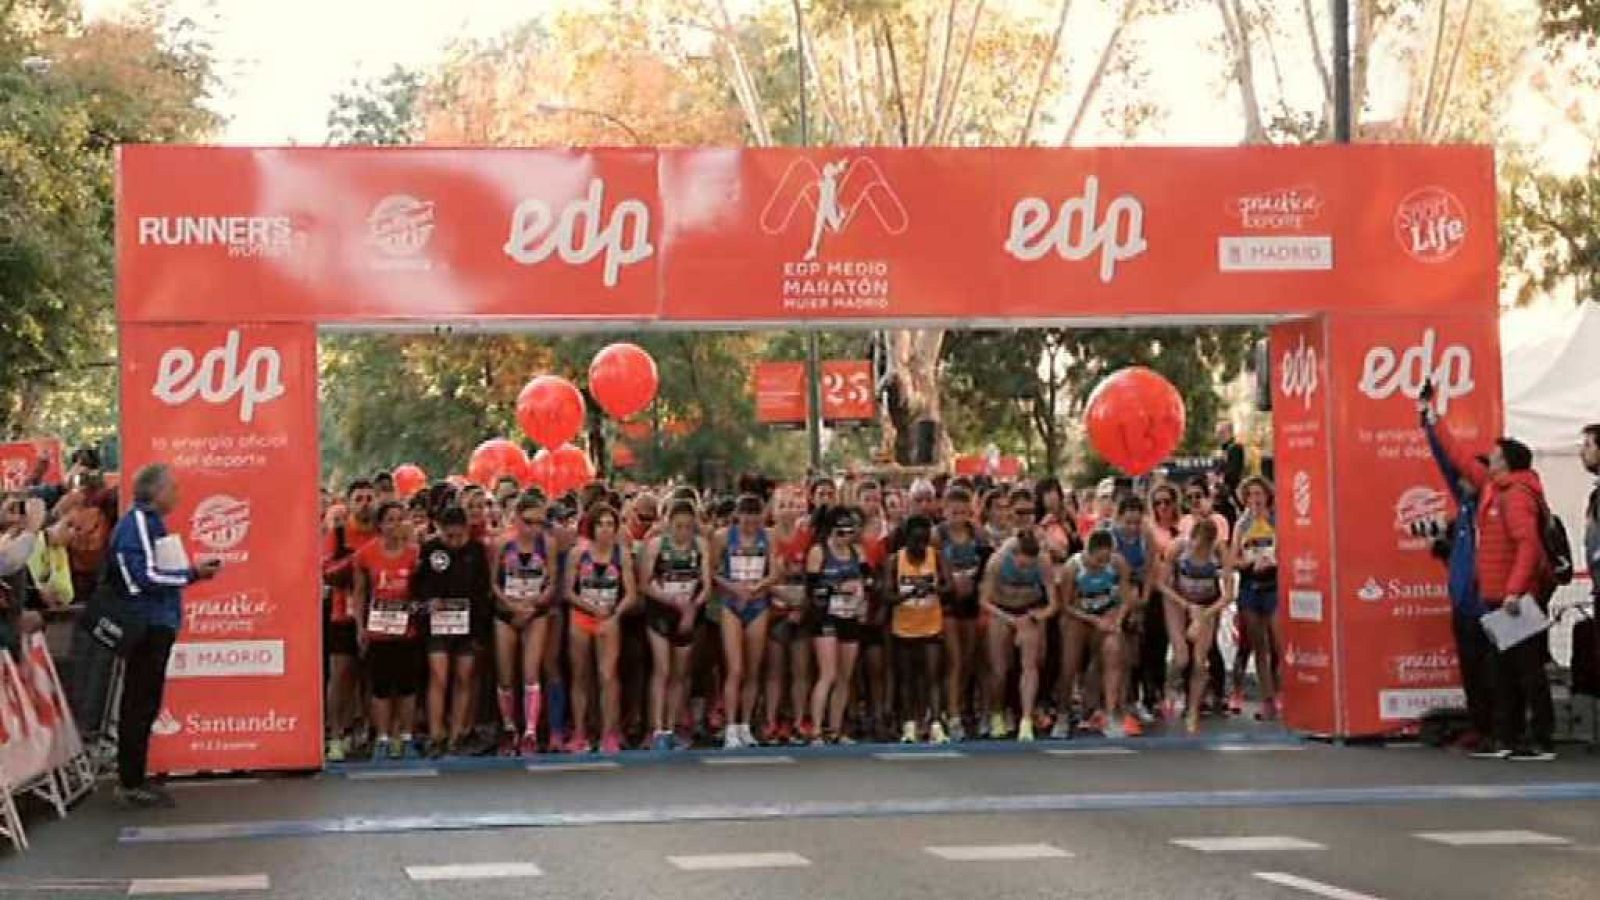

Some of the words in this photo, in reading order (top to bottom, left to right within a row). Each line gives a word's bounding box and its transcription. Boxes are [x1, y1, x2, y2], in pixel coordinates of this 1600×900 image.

[505, 177, 653, 286] edp
[1005, 175, 1147, 282] edp
[1411, 216, 1464, 253] Life
[783, 261, 821, 276] EDP
[827, 261, 888, 276] MEDIO
[1250, 246, 1321, 260] MADRID
[783, 277, 888, 297] MARATÓN
[151, 329, 285, 422] edp
[824, 372, 869, 403] 25
[1357, 328, 1475, 416] edp
[198, 649, 273, 666] MADRID
[186, 709, 298, 734] Santander
